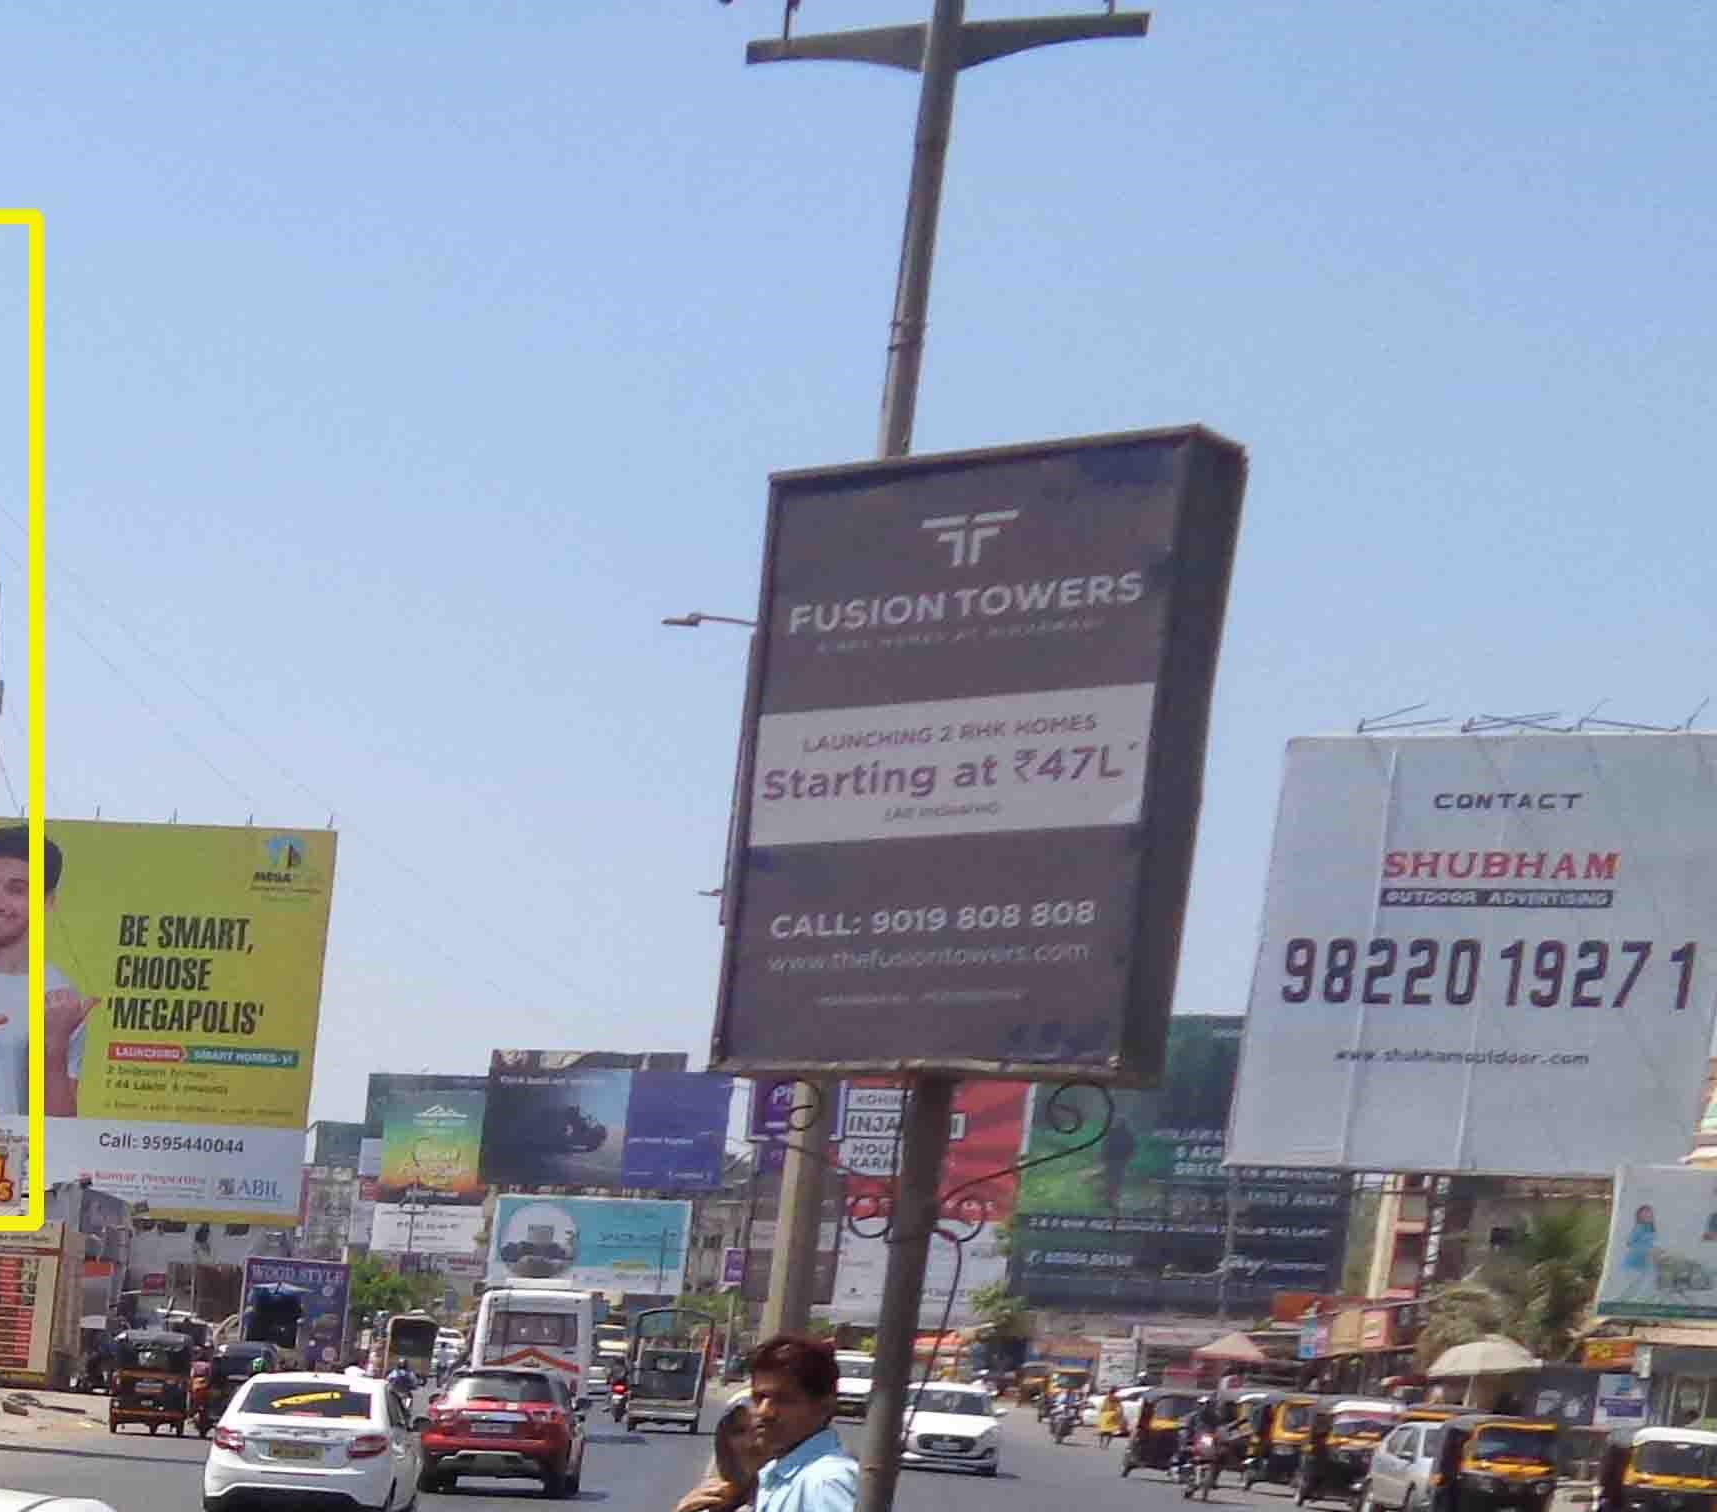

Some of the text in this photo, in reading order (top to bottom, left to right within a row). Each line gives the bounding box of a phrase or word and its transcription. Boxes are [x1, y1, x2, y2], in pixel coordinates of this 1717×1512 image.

[788, 571, 1144, 637] FUSION TOWERS
[802, 727, 933, 753] LAUNCHING
[940, 725, 954, 743] 2
[1014, 713, 1098, 736] HOMES
[763, 759, 936, 801] Starting
[954, 754, 998, 788] at
[1433, 792, 1582, 810] CONTACT
[1382, 850, 1621, 881] SHUBHAM
[1385, 889, 1610, 907] OUTDOOR ADVERTISING
[119, 914, 254, 955] BE SMART,
[770, 901, 1095, 941] CALL: 9019 808 808
[115, 955, 212, 992] CHOOSE
[1281, 937, 1482, 1006] 98220
[106, 997, 265, 1035] 'MEGAPOLIS'
[99, 1132, 244, 1154] Call: 9595440044
